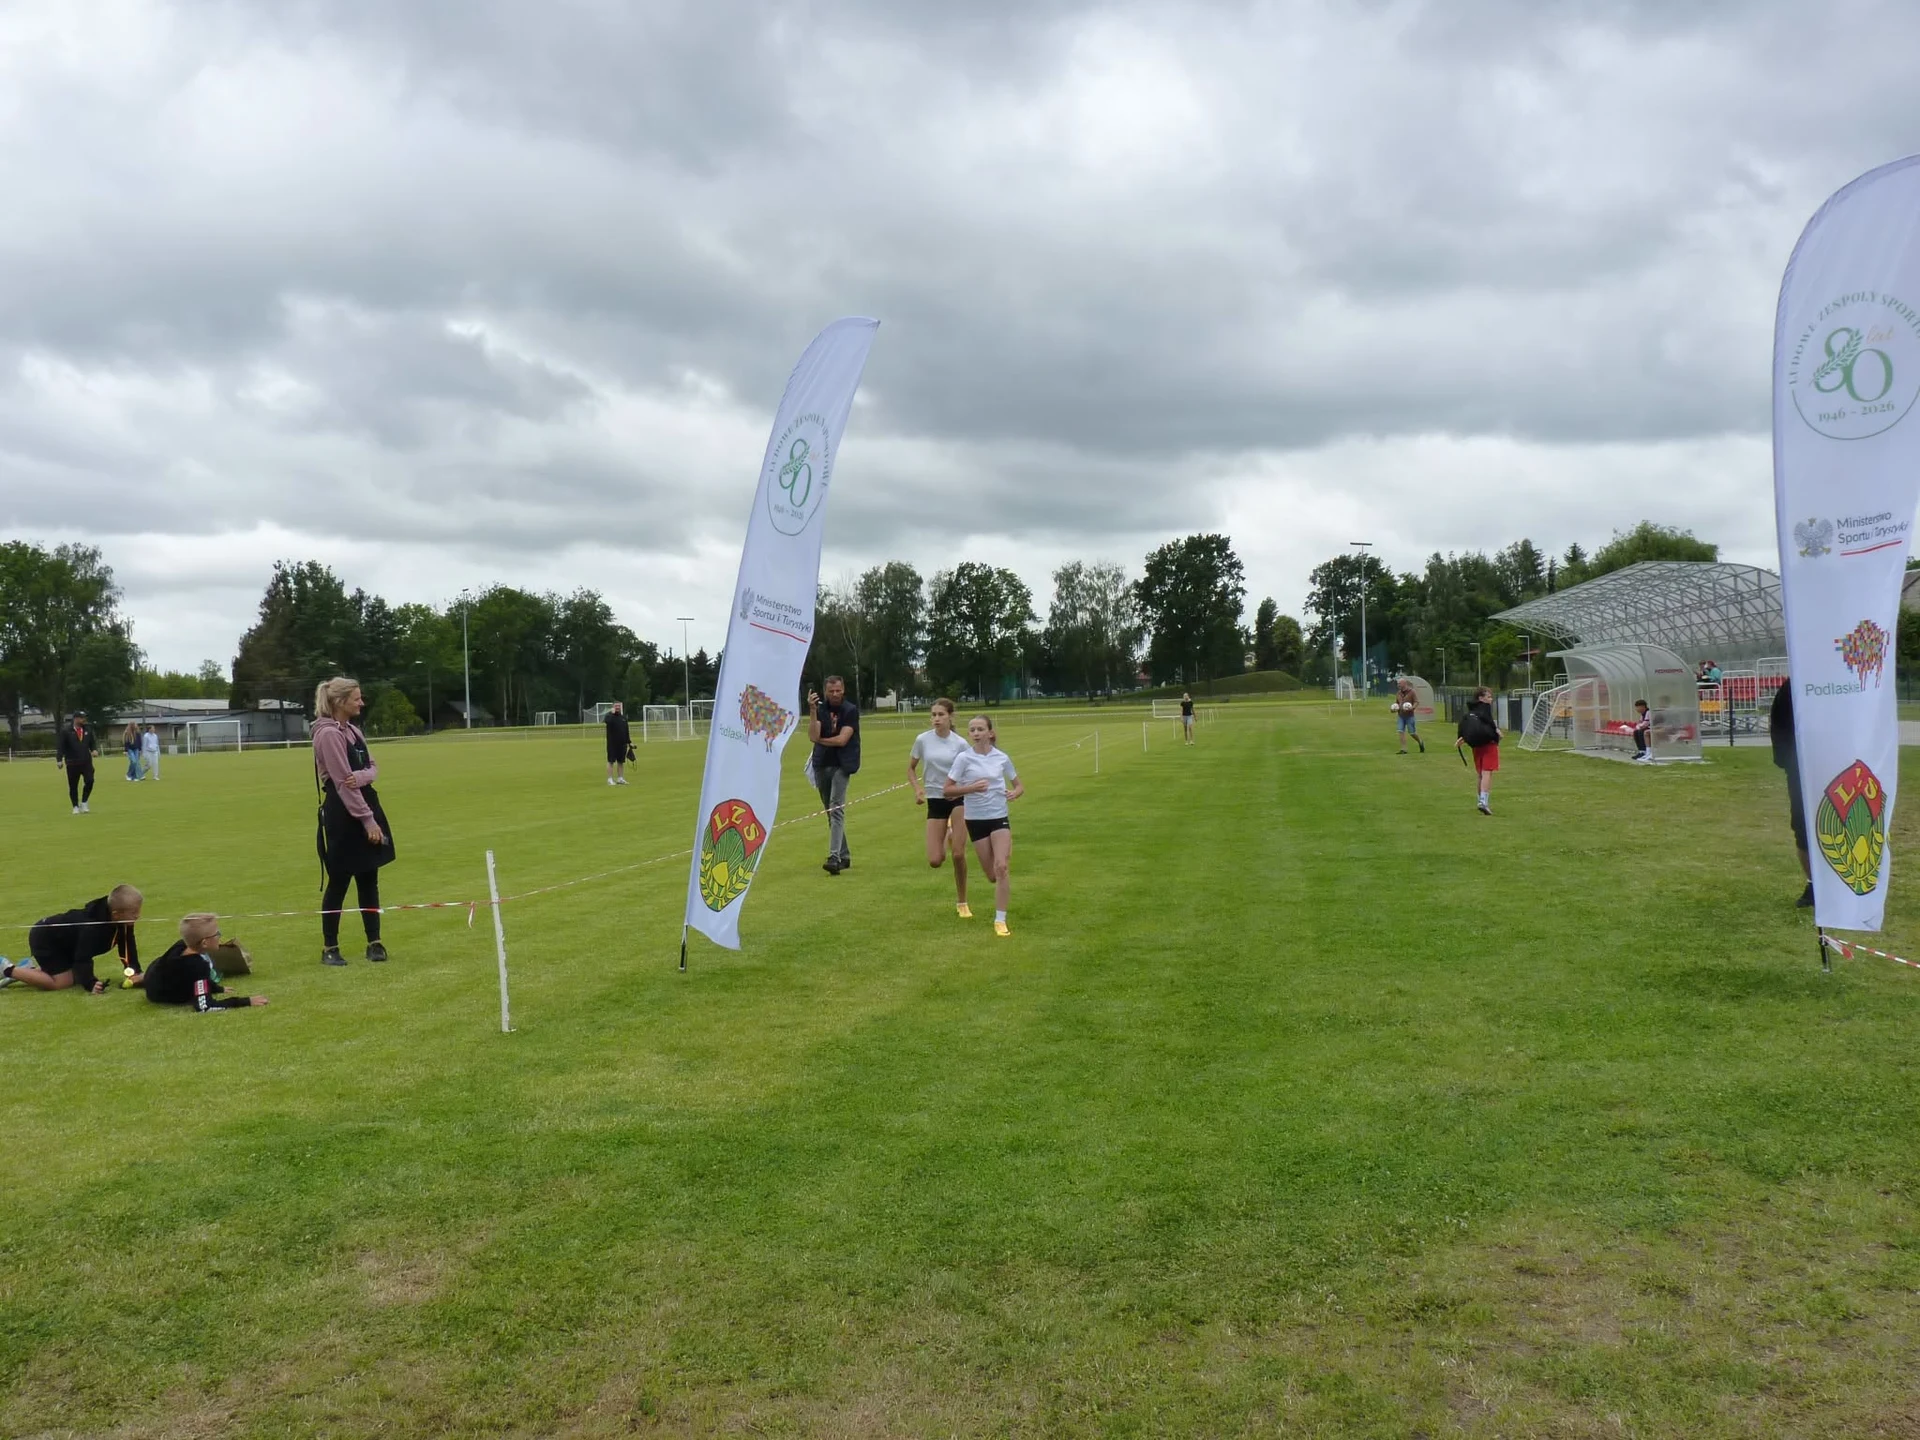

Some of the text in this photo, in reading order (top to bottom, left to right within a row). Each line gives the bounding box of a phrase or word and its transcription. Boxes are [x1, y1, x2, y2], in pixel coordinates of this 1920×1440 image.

[1813, 327, 1893, 402] 80
[1818, 407, 1846, 422] 1946
[1861, 400, 1895, 416] 2026
[779, 438, 811, 507] 80
[1838, 531, 1870, 545] Sportu
[756, 594, 802, 616] Ministerstwo
[752, 606, 776, 621] Sportu
[782, 614, 812, 633] Turystyki
[1805, 682, 1860, 696] Podlaskie
